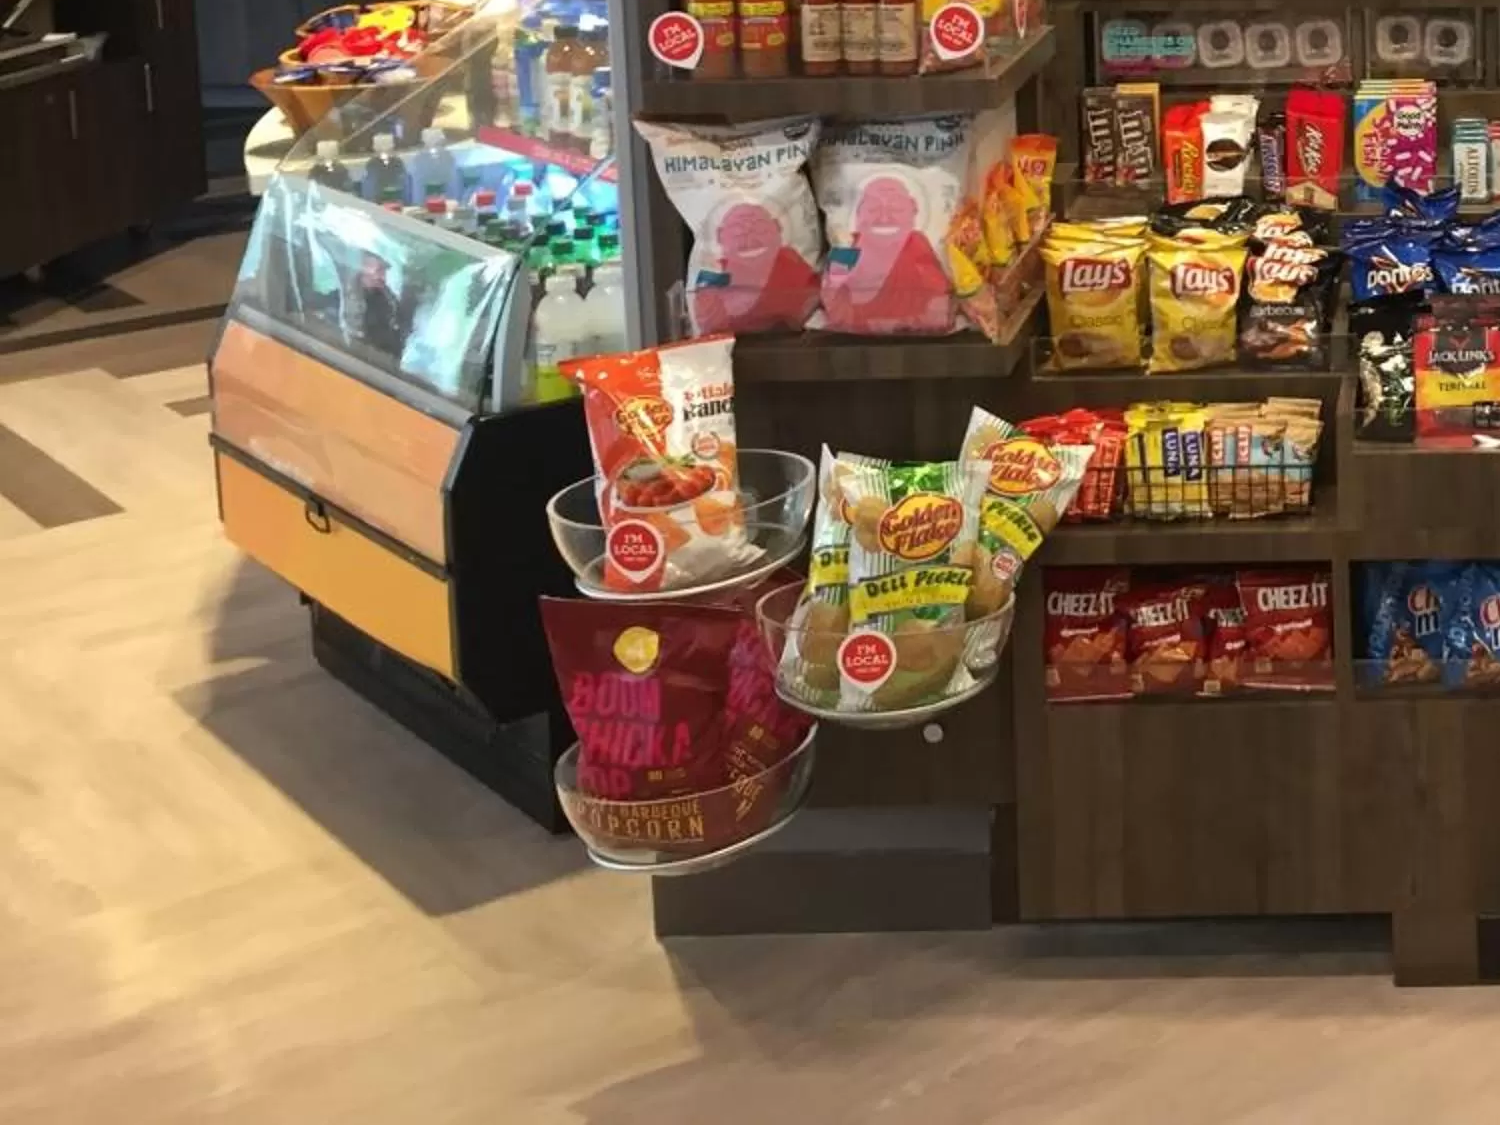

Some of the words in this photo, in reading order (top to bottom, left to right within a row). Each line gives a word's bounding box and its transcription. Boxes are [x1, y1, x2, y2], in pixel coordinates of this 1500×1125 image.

[881, 501, 958, 536] Golden
[614, 544, 657, 556] LOCAL
[846, 654, 888, 668] LOCAL
